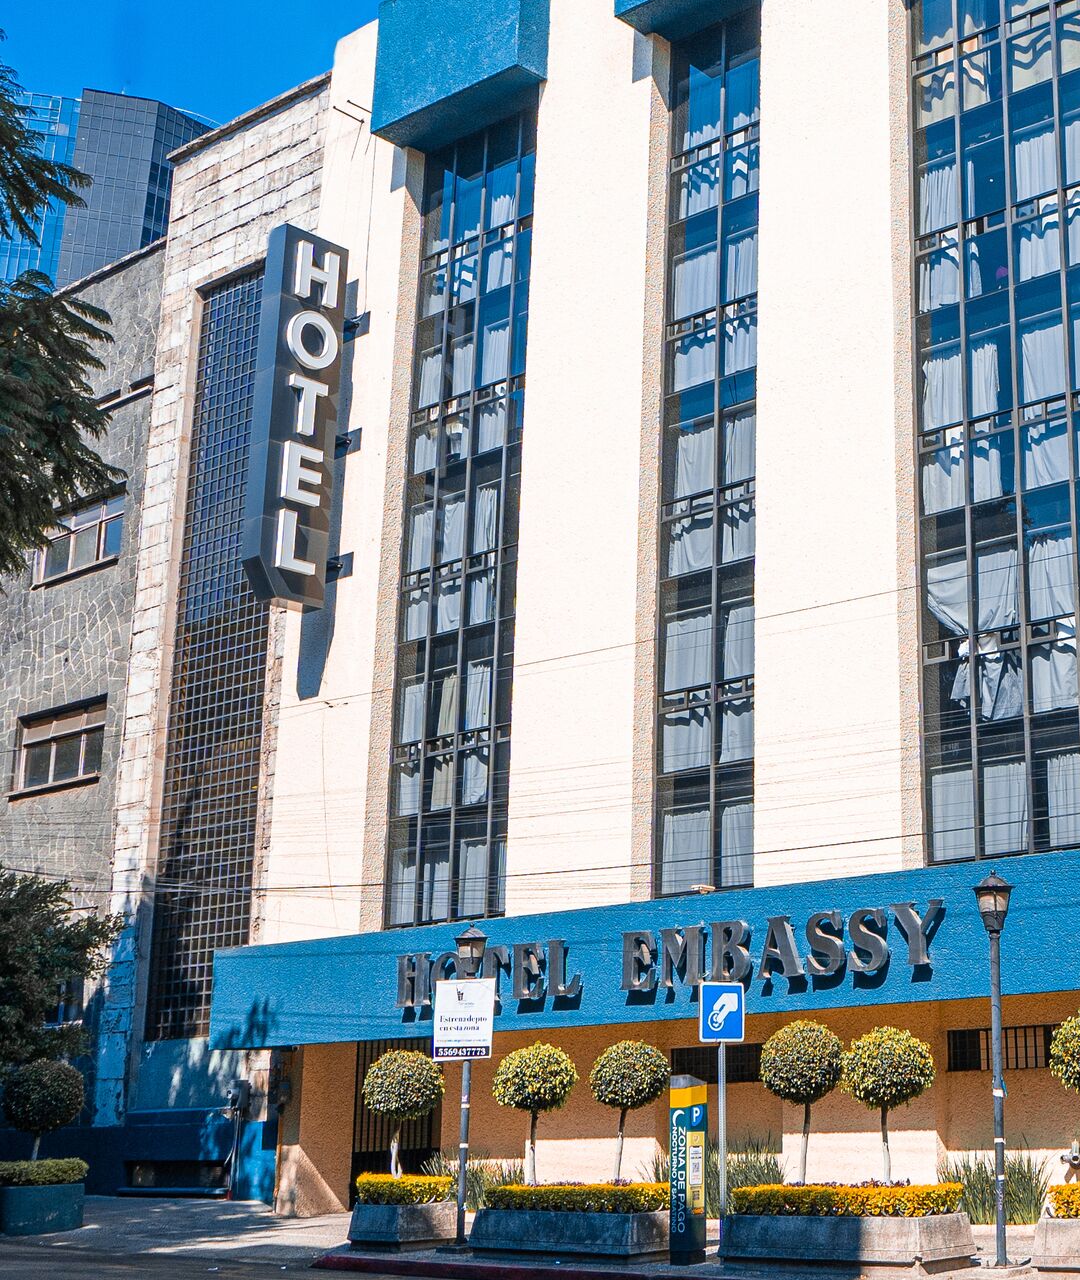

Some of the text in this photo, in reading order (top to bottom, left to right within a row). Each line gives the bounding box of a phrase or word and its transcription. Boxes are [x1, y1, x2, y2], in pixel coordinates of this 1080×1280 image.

[274, 238, 341, 577] HOTEL
[620, 898, 945, 992] EMBASSY
[438, 1047, 486, 1056] 5569437773
[692, 1107, 701, 1123] P
[677, 1126, 686, 1233] ZONA DE PAGO
